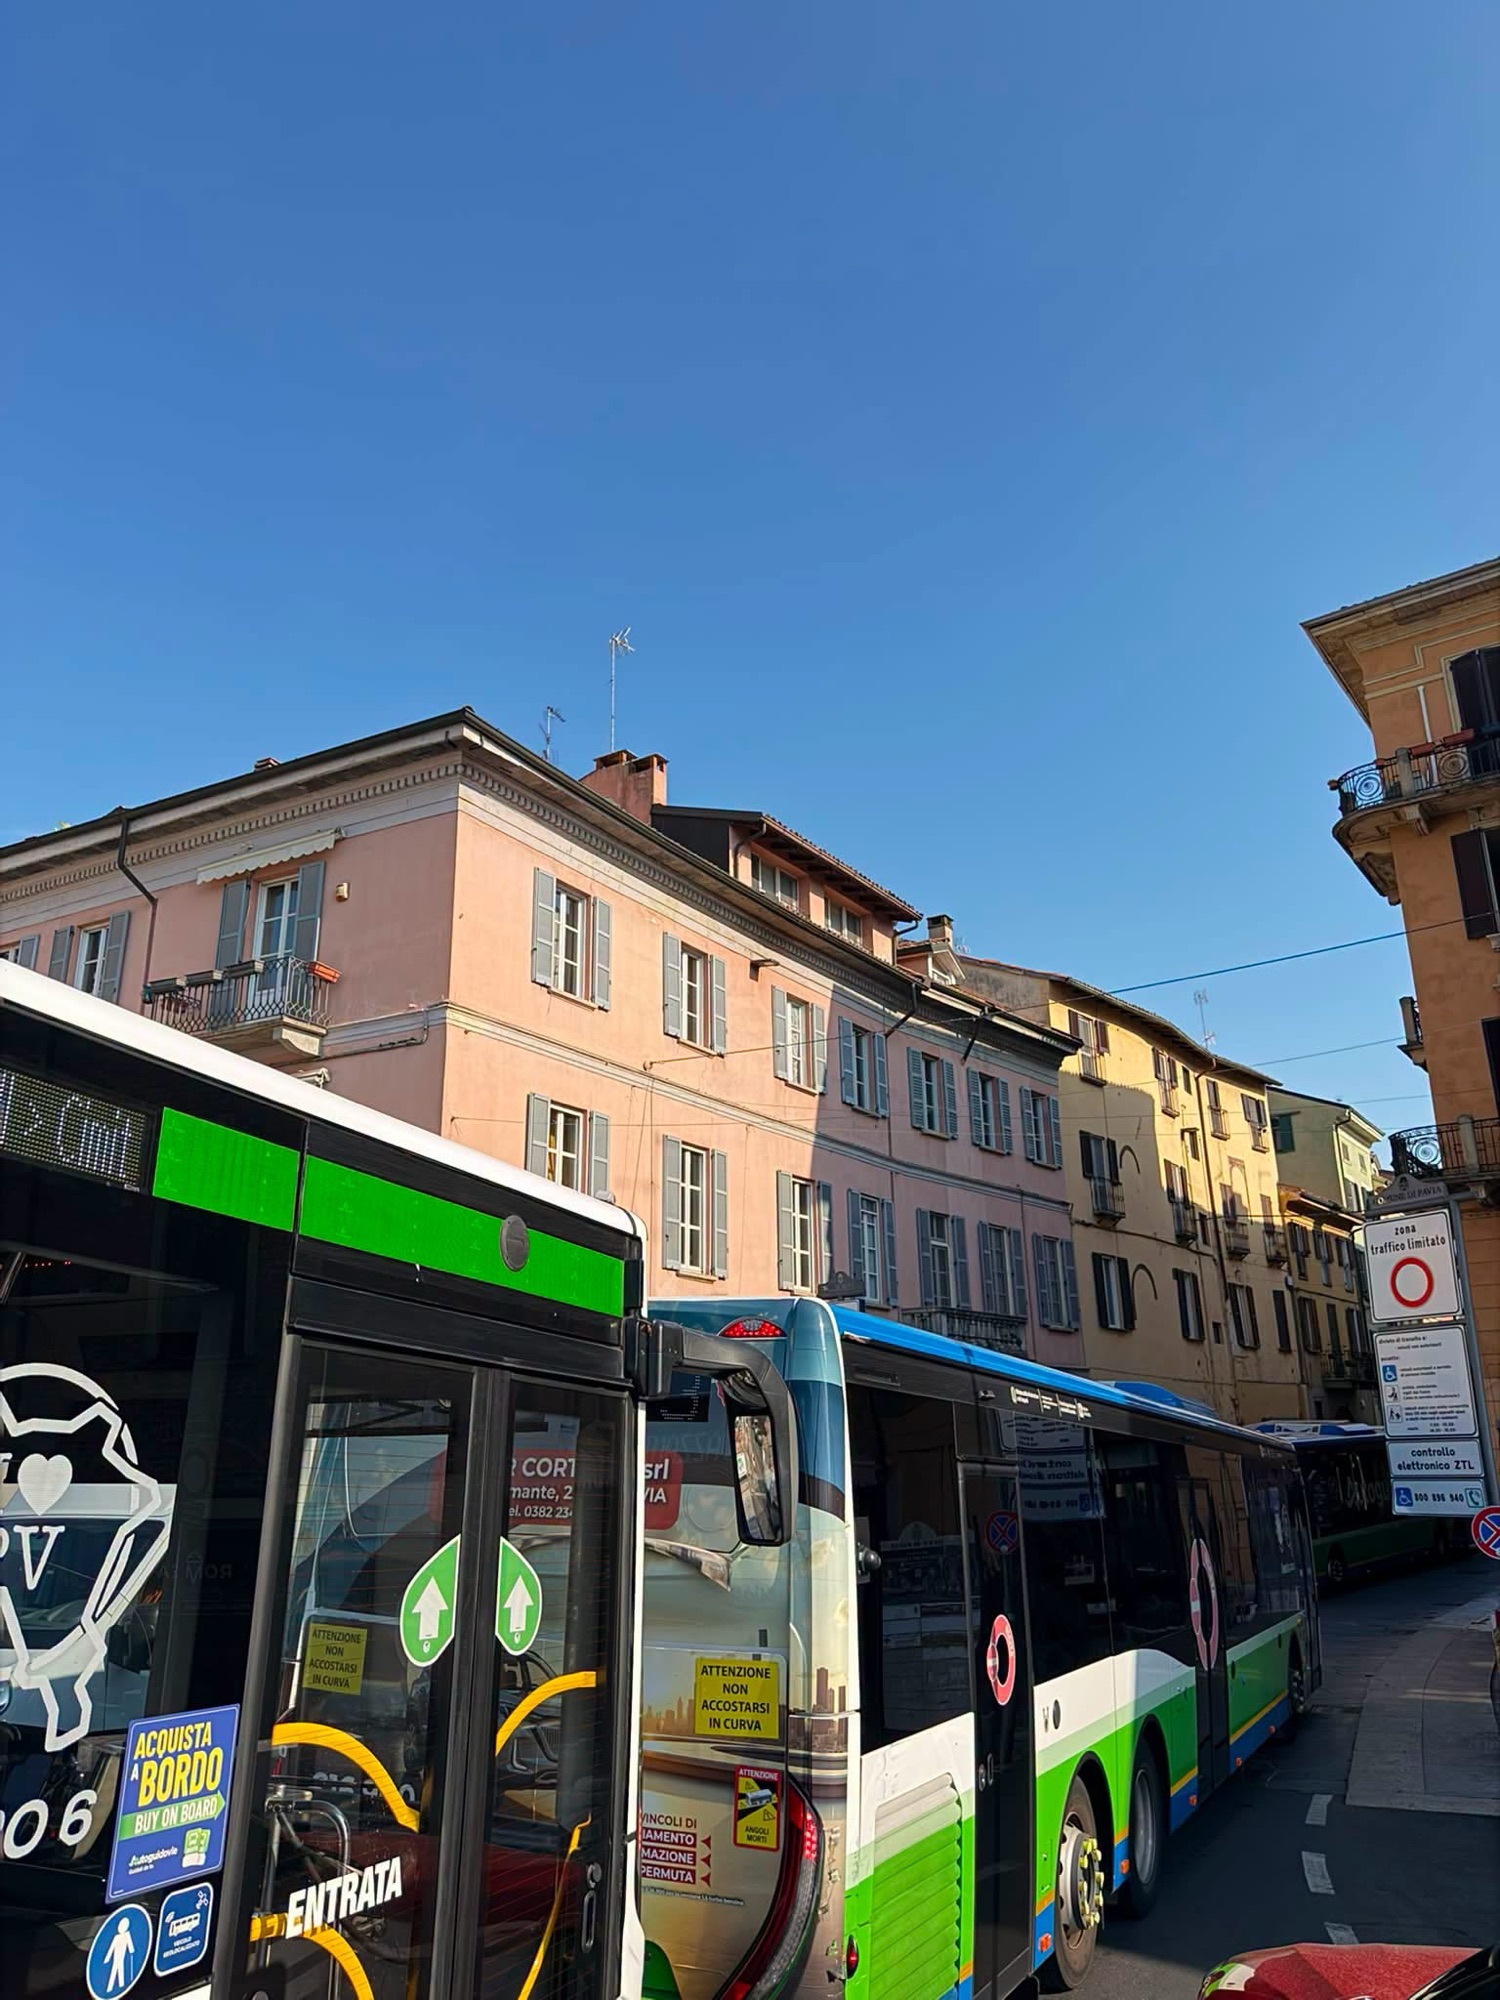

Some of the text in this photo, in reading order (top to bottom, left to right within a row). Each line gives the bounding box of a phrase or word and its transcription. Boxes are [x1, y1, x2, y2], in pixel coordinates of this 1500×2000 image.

[1417, 1186, 1442, 1197] PAVIA
[1394, 1224, 1416, 1236] zona
[1370, 1235, 1446, 1255] traffico limitato
[1411, 1446, 1456, 1457] controllo
[644, 1458, 670, 1480] srl
[1397, 1460, 1475, 1471] elettronico ZTL
[524, 1506, 553, 1518] 0382
[312, 1629, 362, 1644] ATTENZIONE
[325, 1646, 345, 1657] NON
[309, 1658, 358, 1673] ACCOSTARSI
[701, 1665, 771, 1679] ATTENZIONE
[312, 1673, 350, 1688] IN CURVA
[722, 1683, 748, 1695] NON
[701, 1699, 770, 1714] ACCOSTARSI
[709, 1718, 762, 1731] IN CURVA
[133, 1721, 212, 1760] ACQUISTA
[130, 1746, 224, 1807] A BORDO
[738, 1768, 779, 1781] ATTENZIONE
[134, 1796, 218, 1835] BUY ON BOARD
[685, 1818, 697, 1829] DI
[744, 1826, 770, 1836] ANGOLI
[746, 1833, 768, 1843] MORTI
[285, 1856, 403, 1940] ENTRATA
